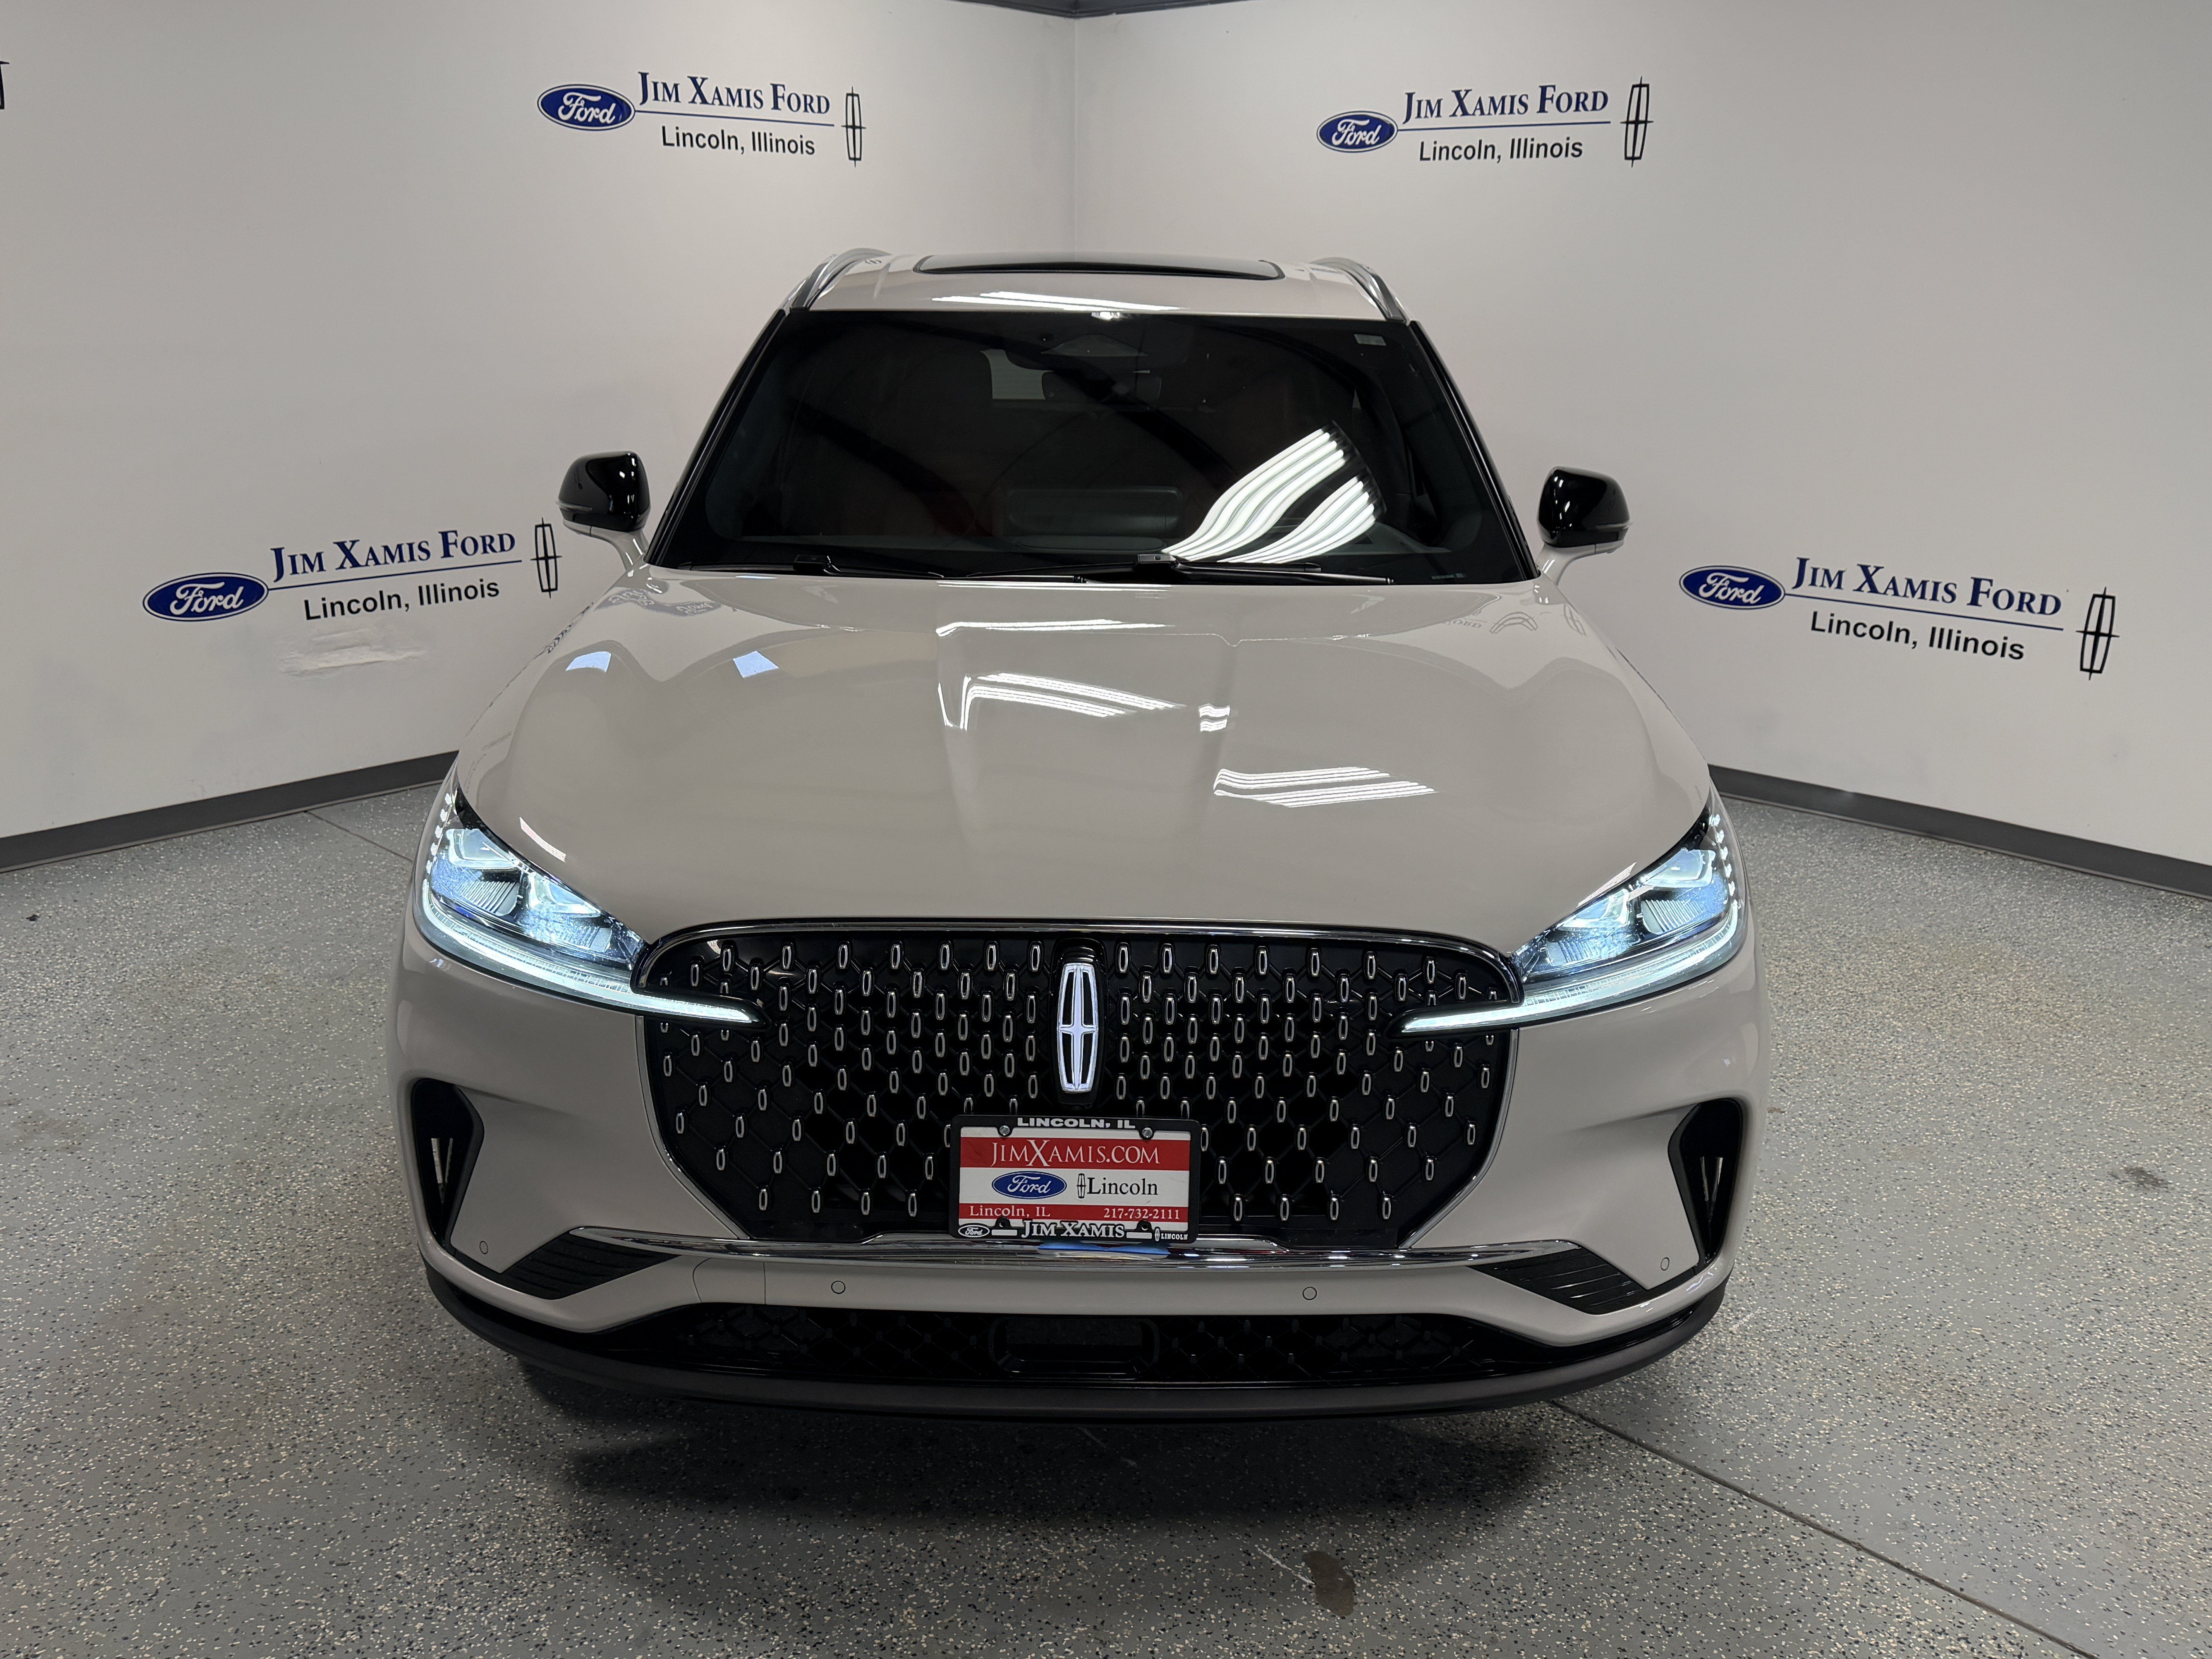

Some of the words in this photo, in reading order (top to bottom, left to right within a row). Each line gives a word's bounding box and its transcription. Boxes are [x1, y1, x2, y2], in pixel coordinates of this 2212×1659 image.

[638, 71, 681, 106] JIM
[687, 76, 763, 109] XAMIS
[770, 83, 830, 114] FORD
[1402, 92, 1443, 125] JIM
[1449, 89, 1528, 117] XAMIS
[1536, 84, 1608, 113] FORD
[558, 92, 616, 124] Ford
[662, 125, 744, 155] Lincoln,
[752, 131, 815, 155] Illinois
[1332, 119, 1382, 146] Ford
[1420, 139, 1501, 163] Lincoln,
[1510, 137, 1583, 159] Illinois
[270, 547, 326, 583] JIM
[333, 539, 431, 570] XAMIS
[438, 530, 515, 558] FORD
[170, 582, 244, 615] Ford
[304, 590, 409, 620] Lincoln,
[418, 578, 500, 606] Illinois
[1698, 572, 1764, 604] Ford
[1791, 557, 1845, 590] JIM
[1853, 563, 1957, 603] XAMIS
[1966, 577, 2061, 615] FORD
[1811, 611, 1917, 649] Lincoln,
[1929, 626, 2024, 660] Illinois
[1017, 1117, 1111, 1128] LINCOLN,
[1117, 1120, 1135, 1128] IL
[991, 1139, 1161, 1167] JIMXAMIS.COM
[1007, 1175, 1052, 1194] Ford
[1087, 1177, 1158, 1195] Lincoln
[970, 1205, 1029, 1218] Lincoln,
[1036, 1207, 1050, 1217] IL
[1104, 1208, 1180, 1219] 217-732-2111
[1021, 1220, 1057, 1238] JIM
[1060, 1221, 1125, 1238] XAMIS
